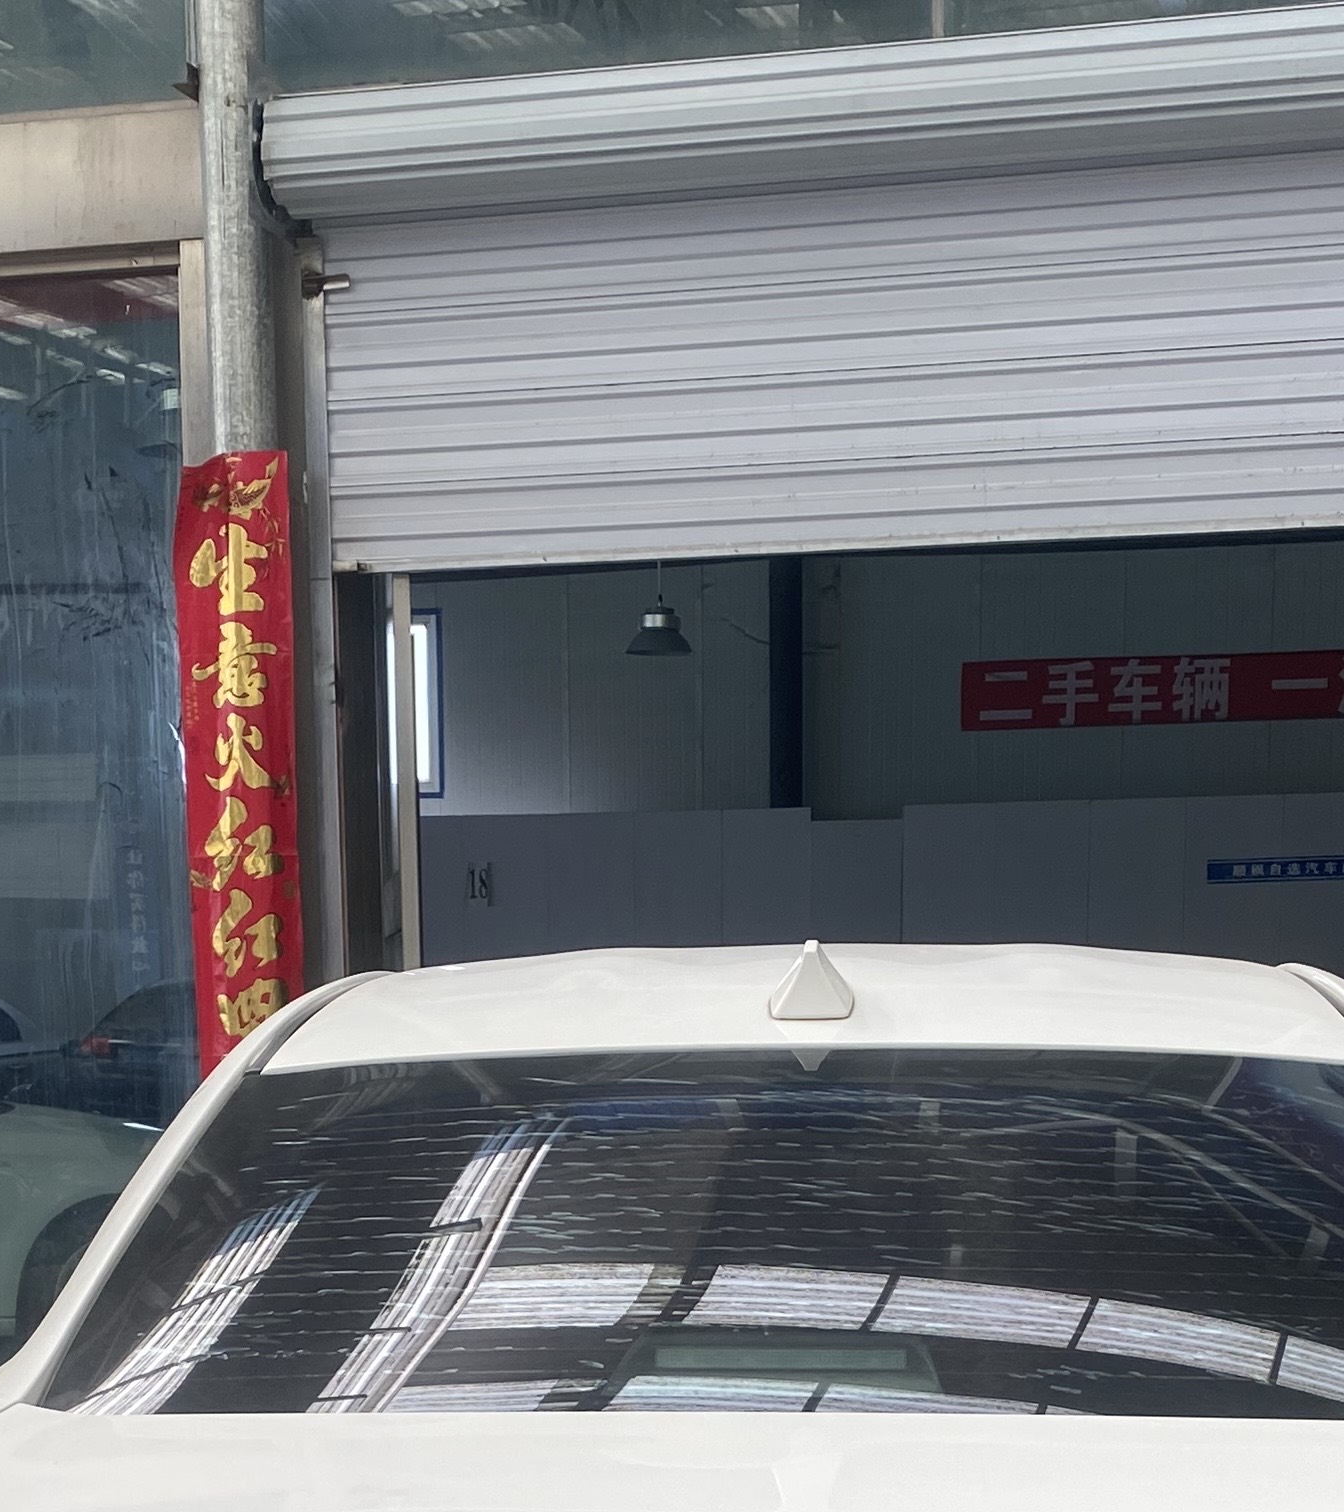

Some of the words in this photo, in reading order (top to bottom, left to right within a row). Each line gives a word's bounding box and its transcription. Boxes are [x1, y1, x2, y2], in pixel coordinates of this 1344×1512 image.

[979, 657, 1232, 727] 二手车辆
[469, 868, 488, 899] 18
